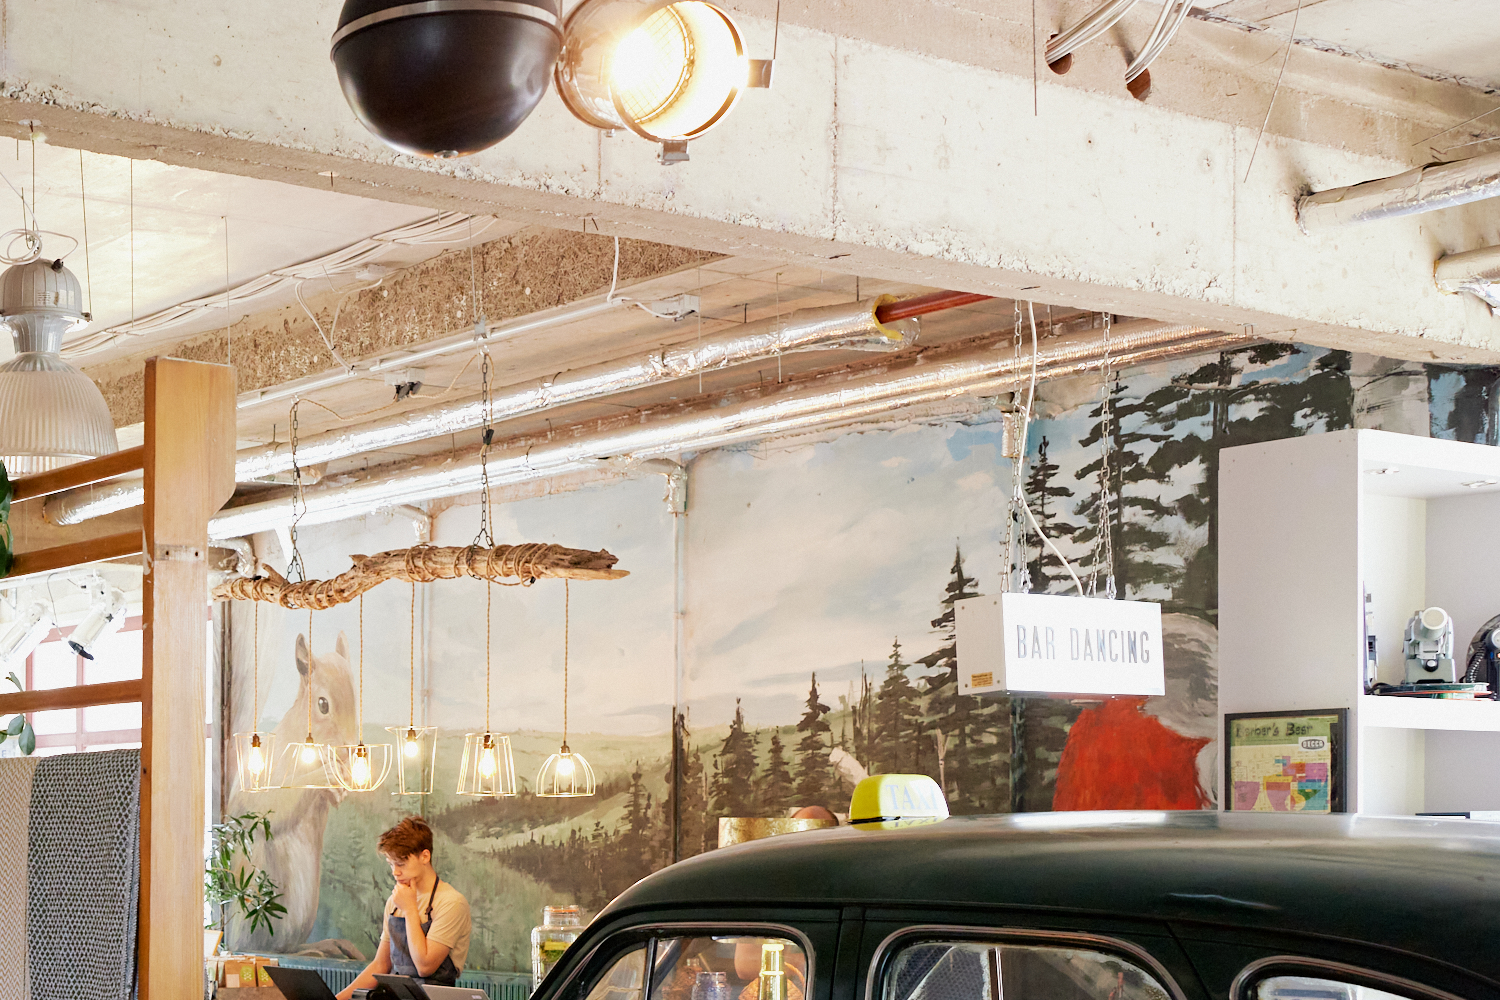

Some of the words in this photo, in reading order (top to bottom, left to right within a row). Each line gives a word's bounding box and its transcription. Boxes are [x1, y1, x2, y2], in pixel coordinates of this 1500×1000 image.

[1016, 624, 1056, 660] BAR
[1069, 627, 1151, 664] DANCING
[1301, 740, 1325, 748] DECCA
[885, 784, 939, 811] TAXI
